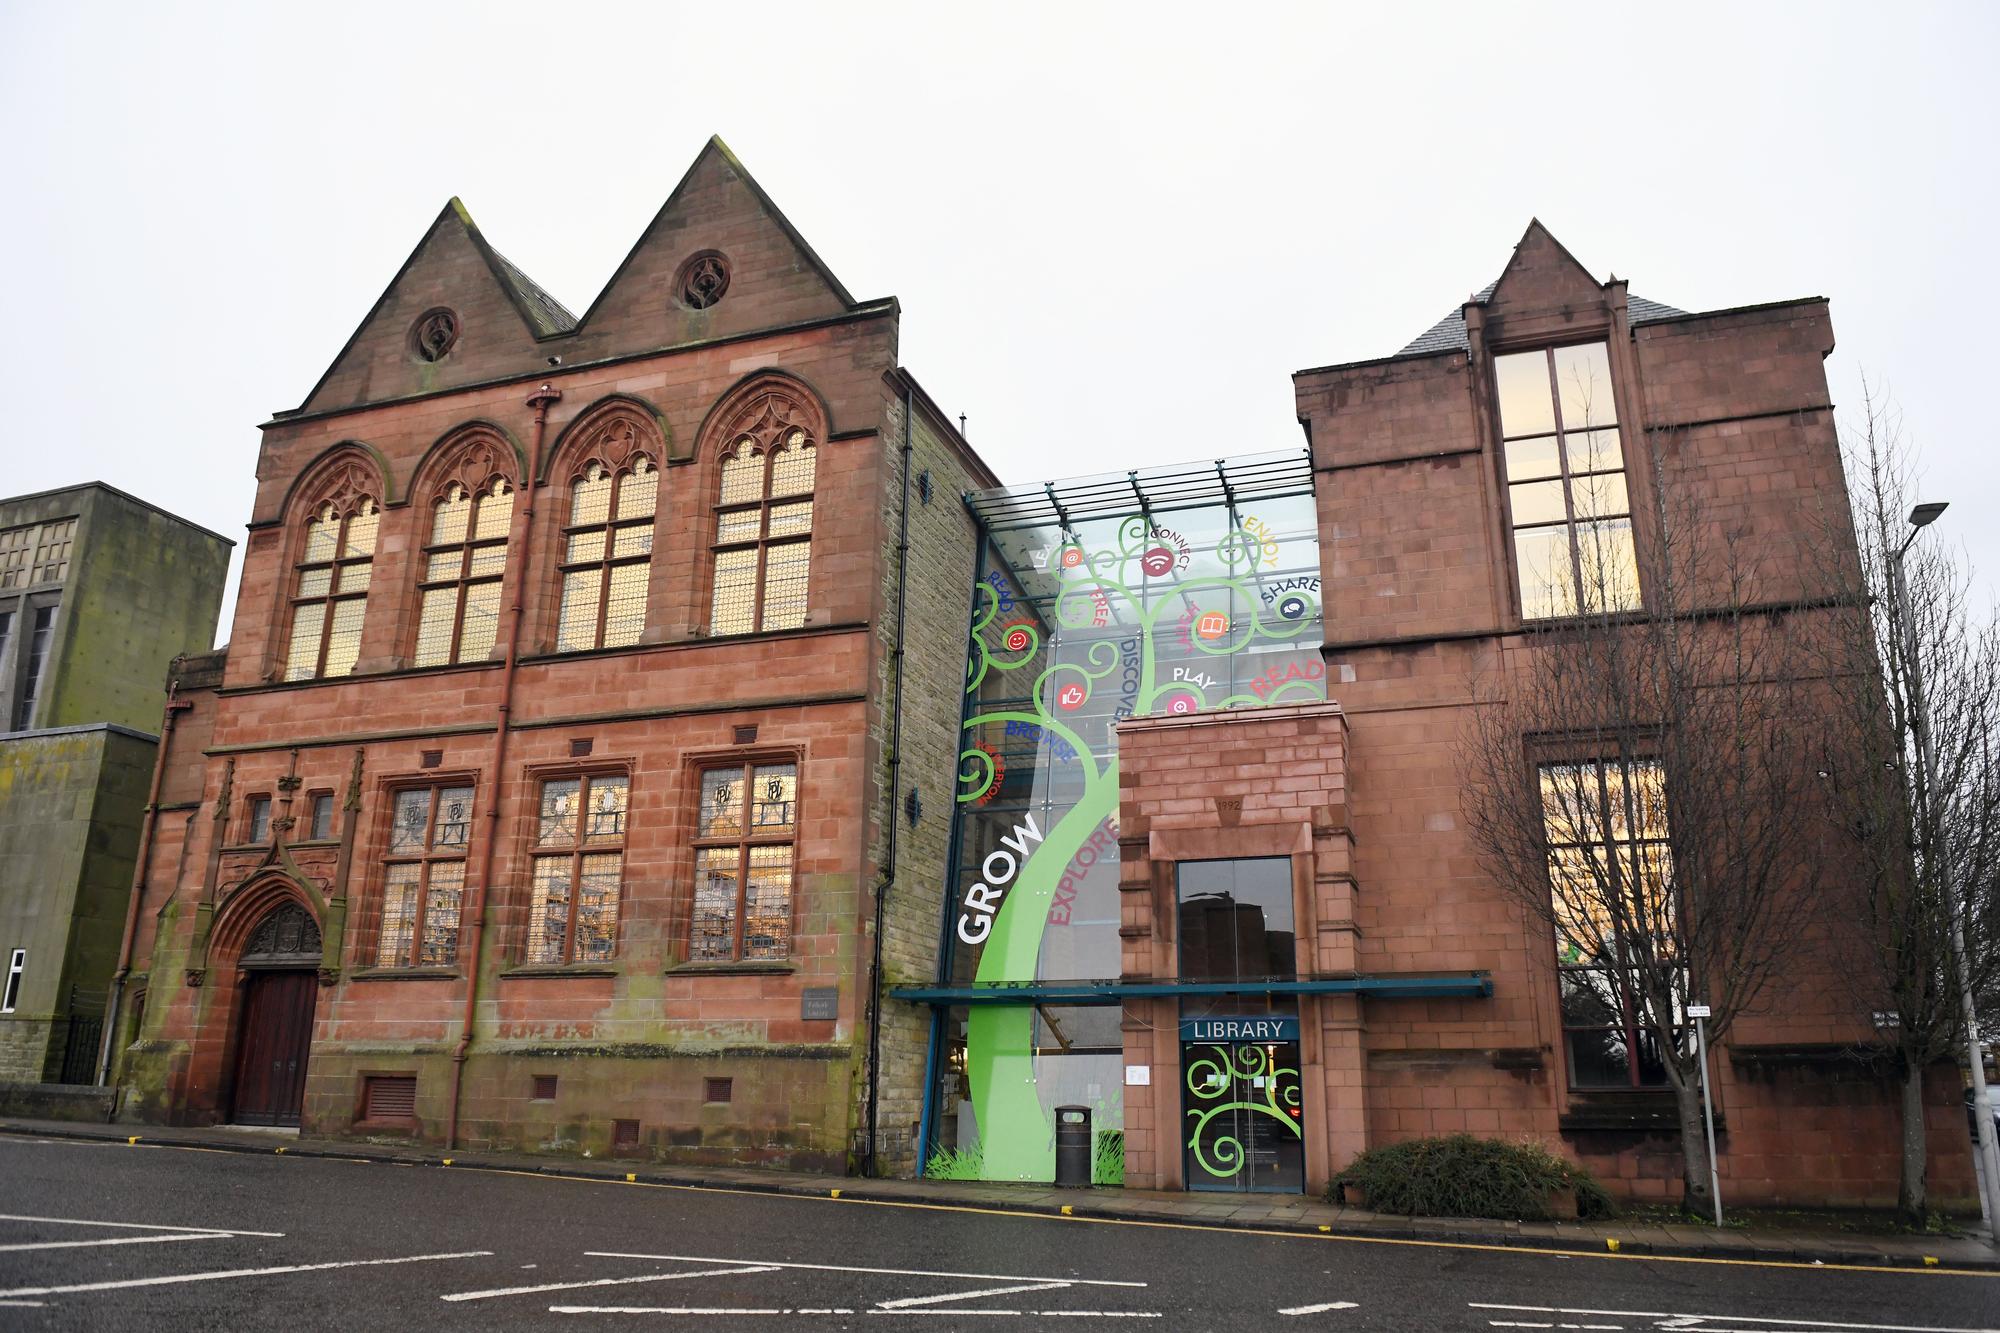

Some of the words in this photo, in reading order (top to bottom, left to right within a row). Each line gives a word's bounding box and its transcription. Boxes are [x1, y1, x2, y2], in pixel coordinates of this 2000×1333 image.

[1151, 529, 1191, 571] CONNECT
[1244, 516, 1279, 568] ENJOY
[986, 570, 1014, 612] READ
[1089, 589, 1109, 628] FREE
[1261, 576, 1322, 604] SHARE
[1113, 639, 1139, 723] DISCOVE
[1173, 667, 1217, 690] PLAY
[1250, 658, 1324, 698] READ
[1006, 720, 1077, 764] BROWSE
[1217, 800, 1241, 811] 1992
[957, 811, 1044, 945] GROW
[1048, 817, 1120, 927] EXPLORE
[1194, 1021, 1284, 1038] LIBRARY
